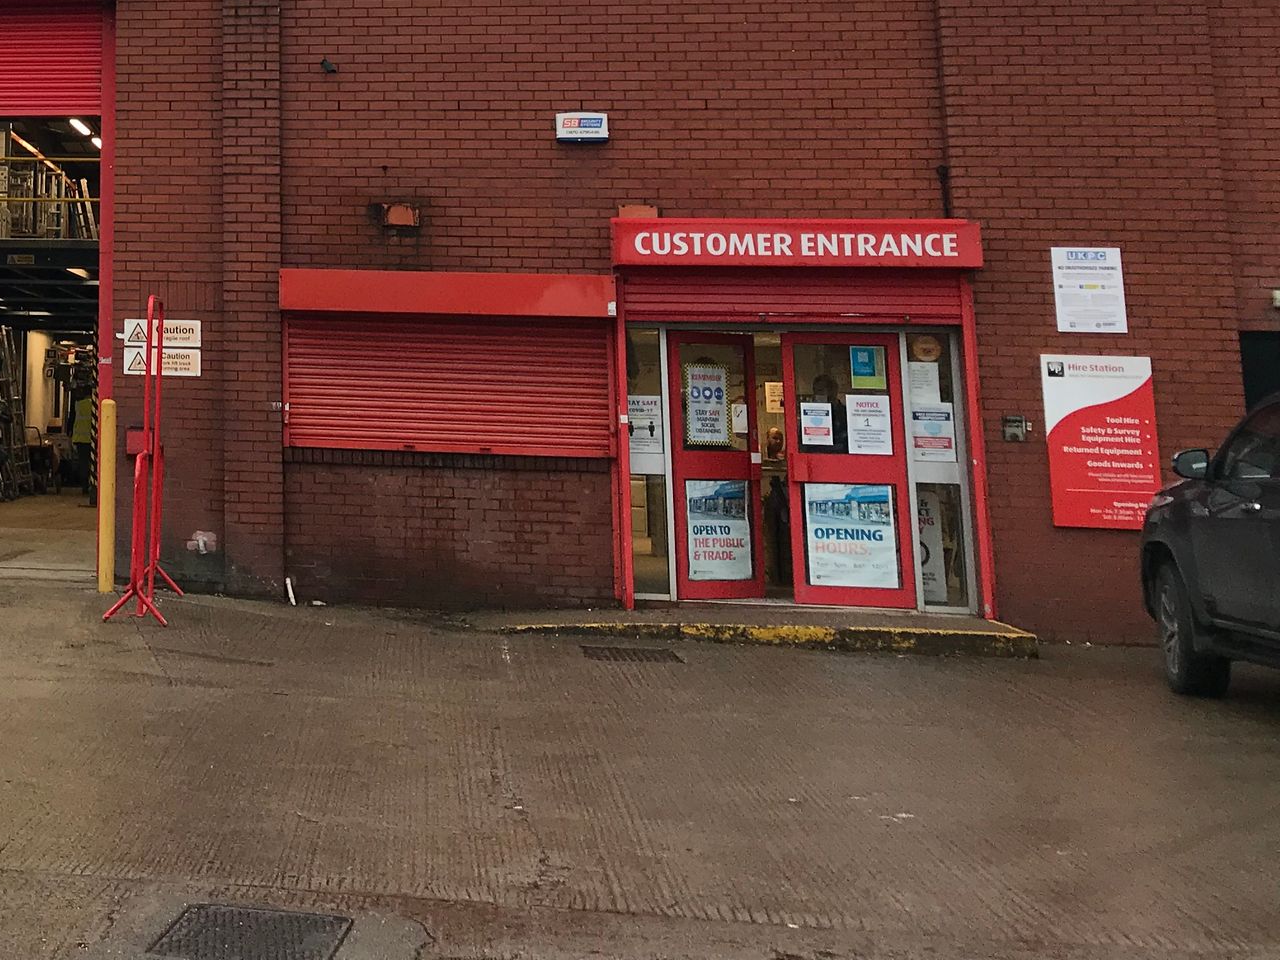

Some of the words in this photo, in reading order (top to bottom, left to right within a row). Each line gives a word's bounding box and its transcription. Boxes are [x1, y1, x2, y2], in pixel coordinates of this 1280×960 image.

[634, 232, 793, 257] CUSTOMER
[801, 233, 959, 257] ENTRANCE
[1068, 252, 1106, 260] UKPC
[1068, 363, 1088, 372] Hire
[1090, 364, 1125, 373] Station
[1105, 416, 1122, 424] Tool
[1123, 417, 1140, 425] Hire
[1080, 426, 1106, 435] Safety
[1114, 428, 1141, 437] Survey
[1081, 434, 1124, 443] Equipment
[1124, 436, 1142, 444] Hire
[1063, 446, 1100, 454] Returned
[1100, 447, 1143, 456] Equipment
[1087, 460, 1111, 468] Goods
[692, 524, 718, 536] OPEN
[718, 524, 731, 536] TO
[814, 527, 884, 542] OPENING
[693, 537, 711, 548] THE
[712, 537, 745, 549] PUBLIC
[815, 541, 872, 556] HOURS.
[693, 550, 701, 561] &
[702, 550, 737, 561] TRADE.
